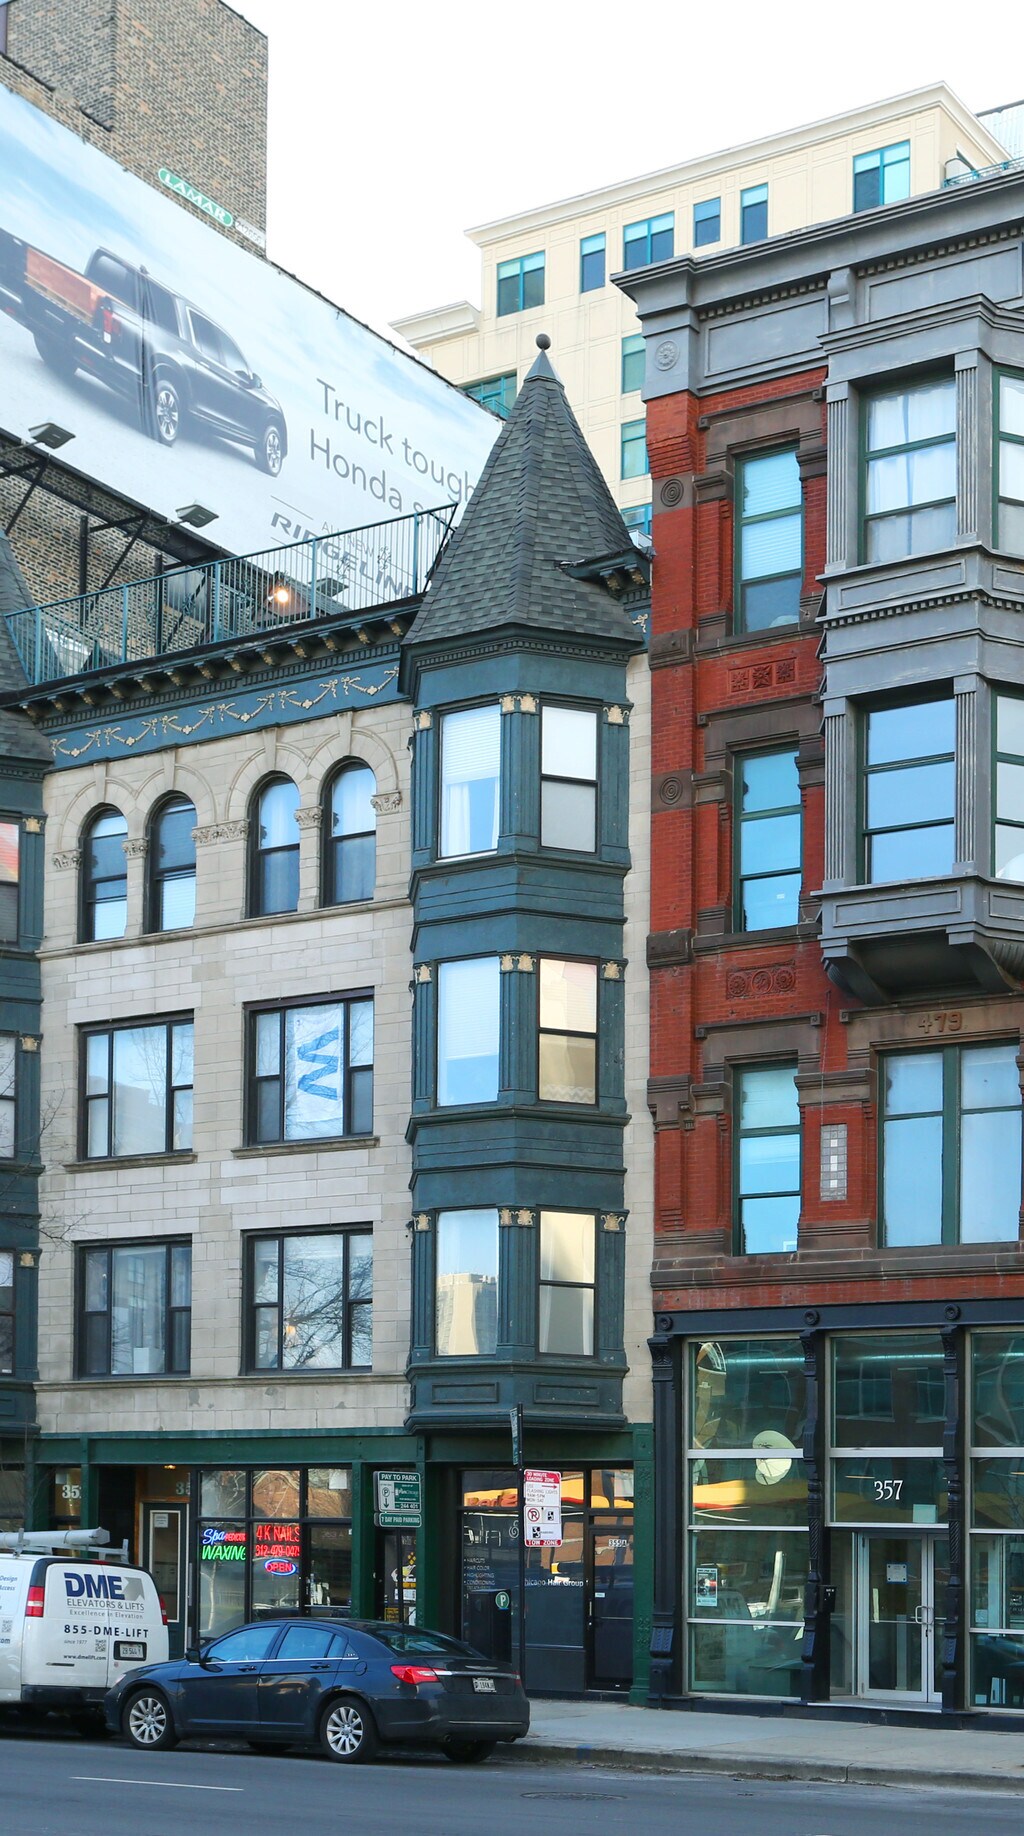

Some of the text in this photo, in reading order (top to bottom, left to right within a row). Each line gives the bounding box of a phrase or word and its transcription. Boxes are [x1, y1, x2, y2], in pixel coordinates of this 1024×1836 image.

[164, 173, 226, 222] LAMAR
[316, 377, 476, 503] Truck tough
[310, 428, 402, 512] Honda
[918, 1011, 963, 1034] 479
[62, 1484, 82, 1499] 35
[874, 1479, 904, 1501] 357
[202, 1528, 226, 1545] Spa
[273, 1525, 300, 1542] NAILS
[266, 1563, 293, 1573] OPEN
[64, 1572, 126, 1600] DME
[525, 1578, 584, 1588] hicago Hair Group
[67, 1598, 145, 1611] ELEVATORS & LIFTS
[115, 1611, 144, 1620] Elevation
[64, 1624, 149, 1638] 855-DME-LIFT
